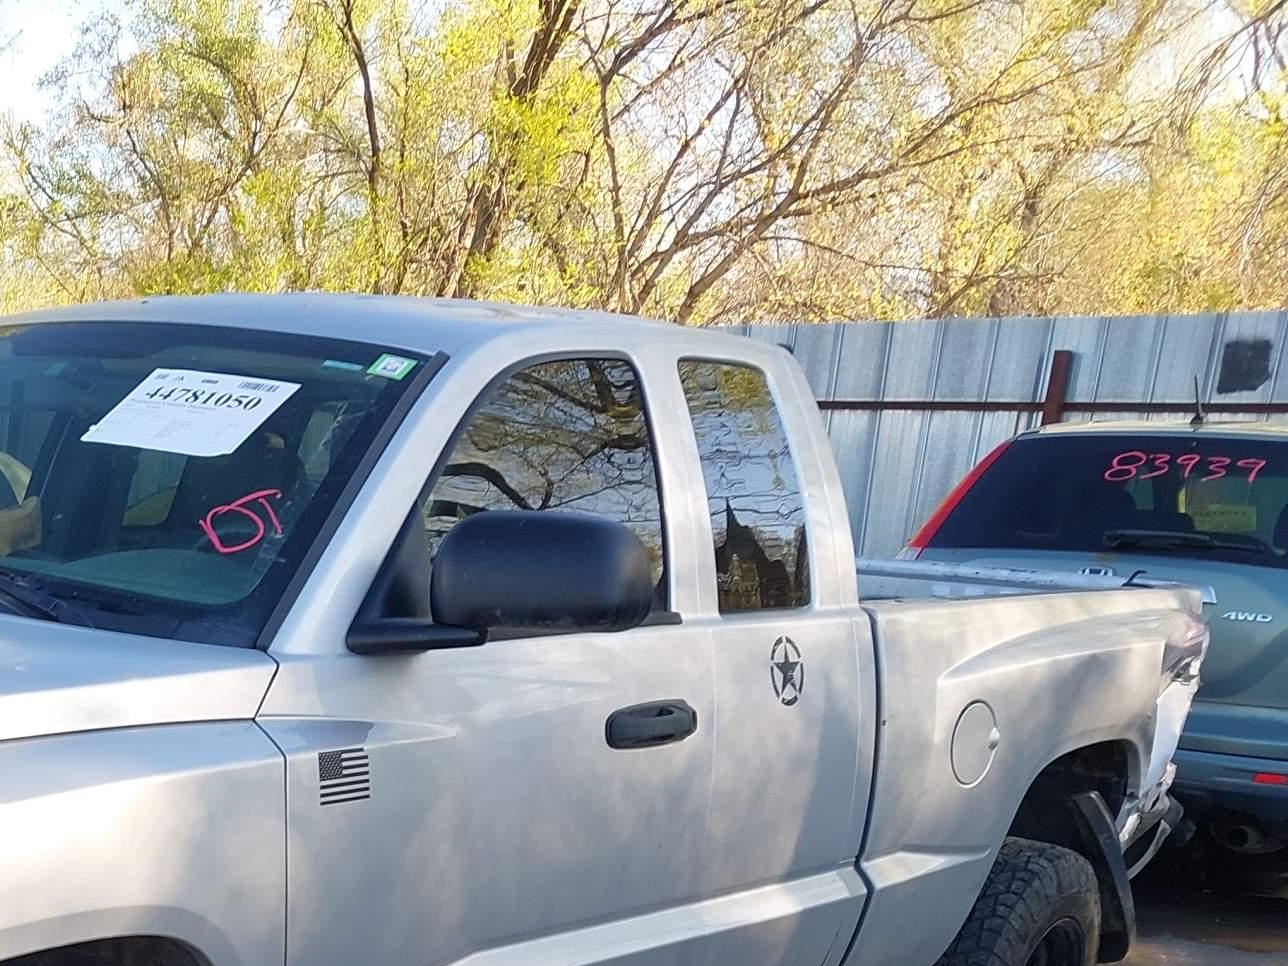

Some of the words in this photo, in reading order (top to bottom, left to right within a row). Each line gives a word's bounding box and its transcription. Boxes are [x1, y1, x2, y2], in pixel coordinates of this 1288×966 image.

[145, 386, 262, 411] 44781050
[1104, 451, 1266, 482] 83939
[1221, 611, 1273, 622] 4WD
